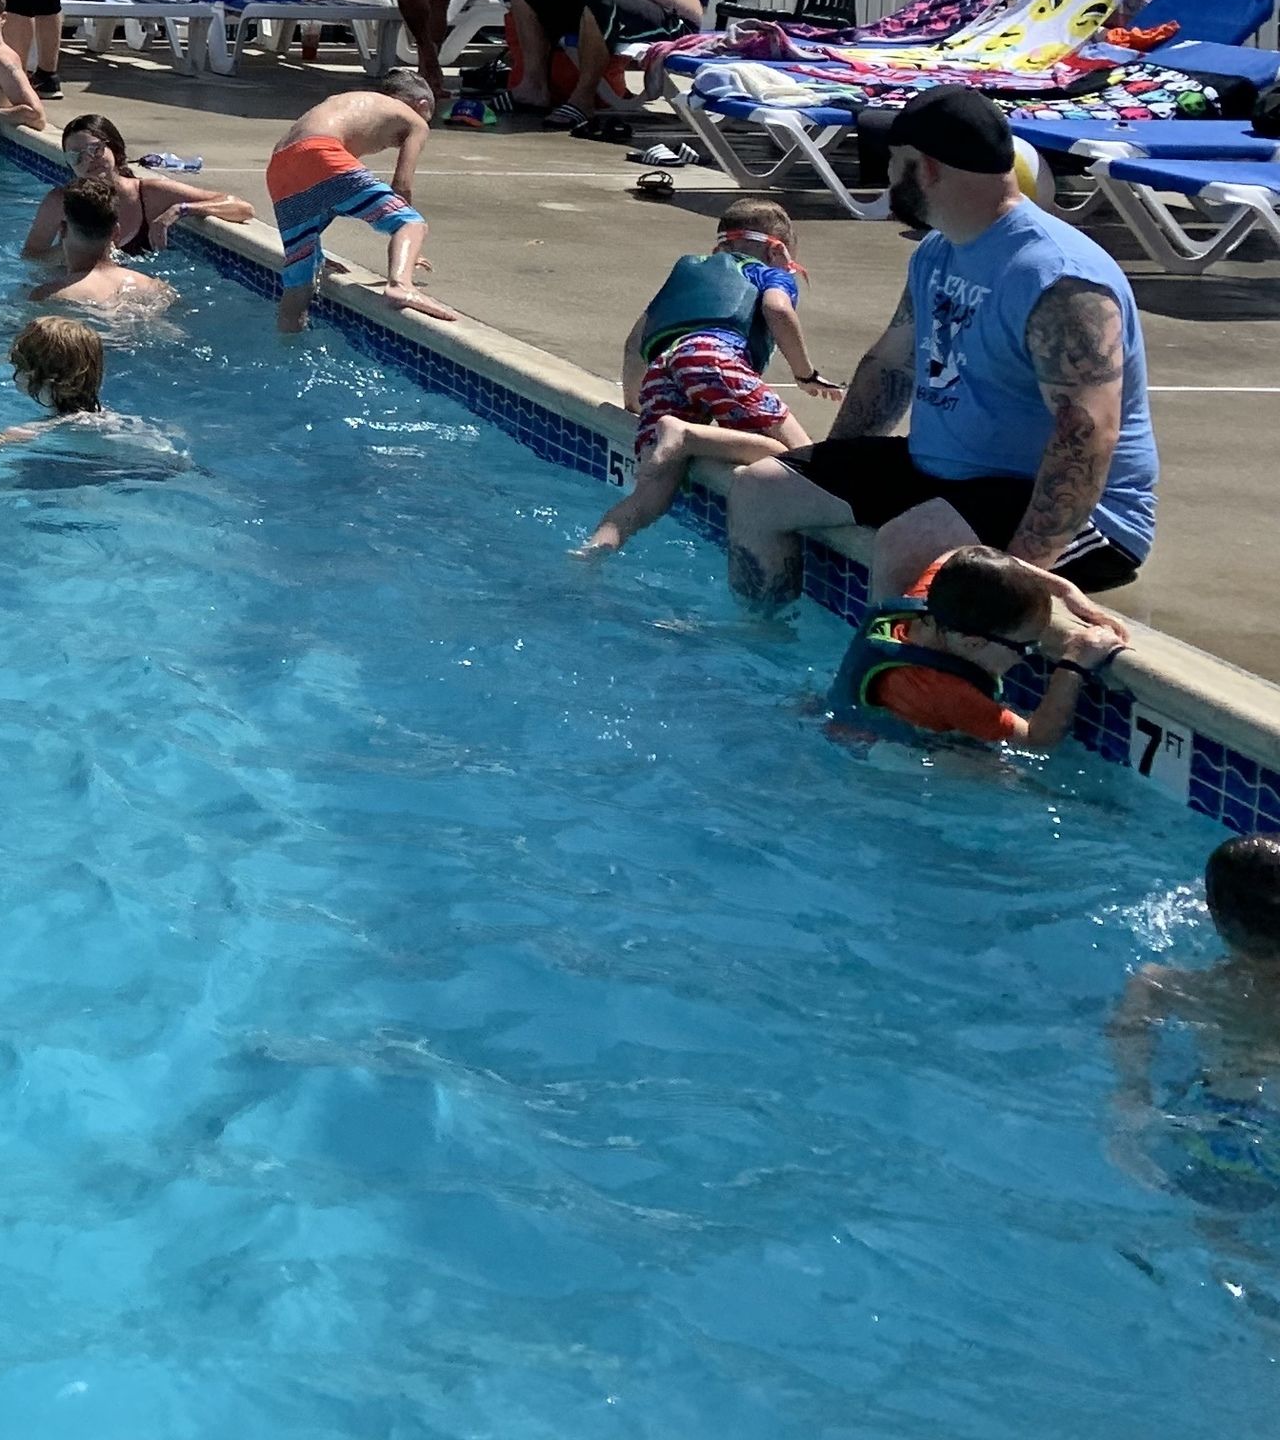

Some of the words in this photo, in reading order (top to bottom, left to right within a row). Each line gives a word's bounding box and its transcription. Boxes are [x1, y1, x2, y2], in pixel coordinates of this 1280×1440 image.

[610, 450, 624, 487] 5
[625, 457, 635, 476] FT
[1136, 715, 1163, 777] 7
[1166, 730, 1185, 759] FT
